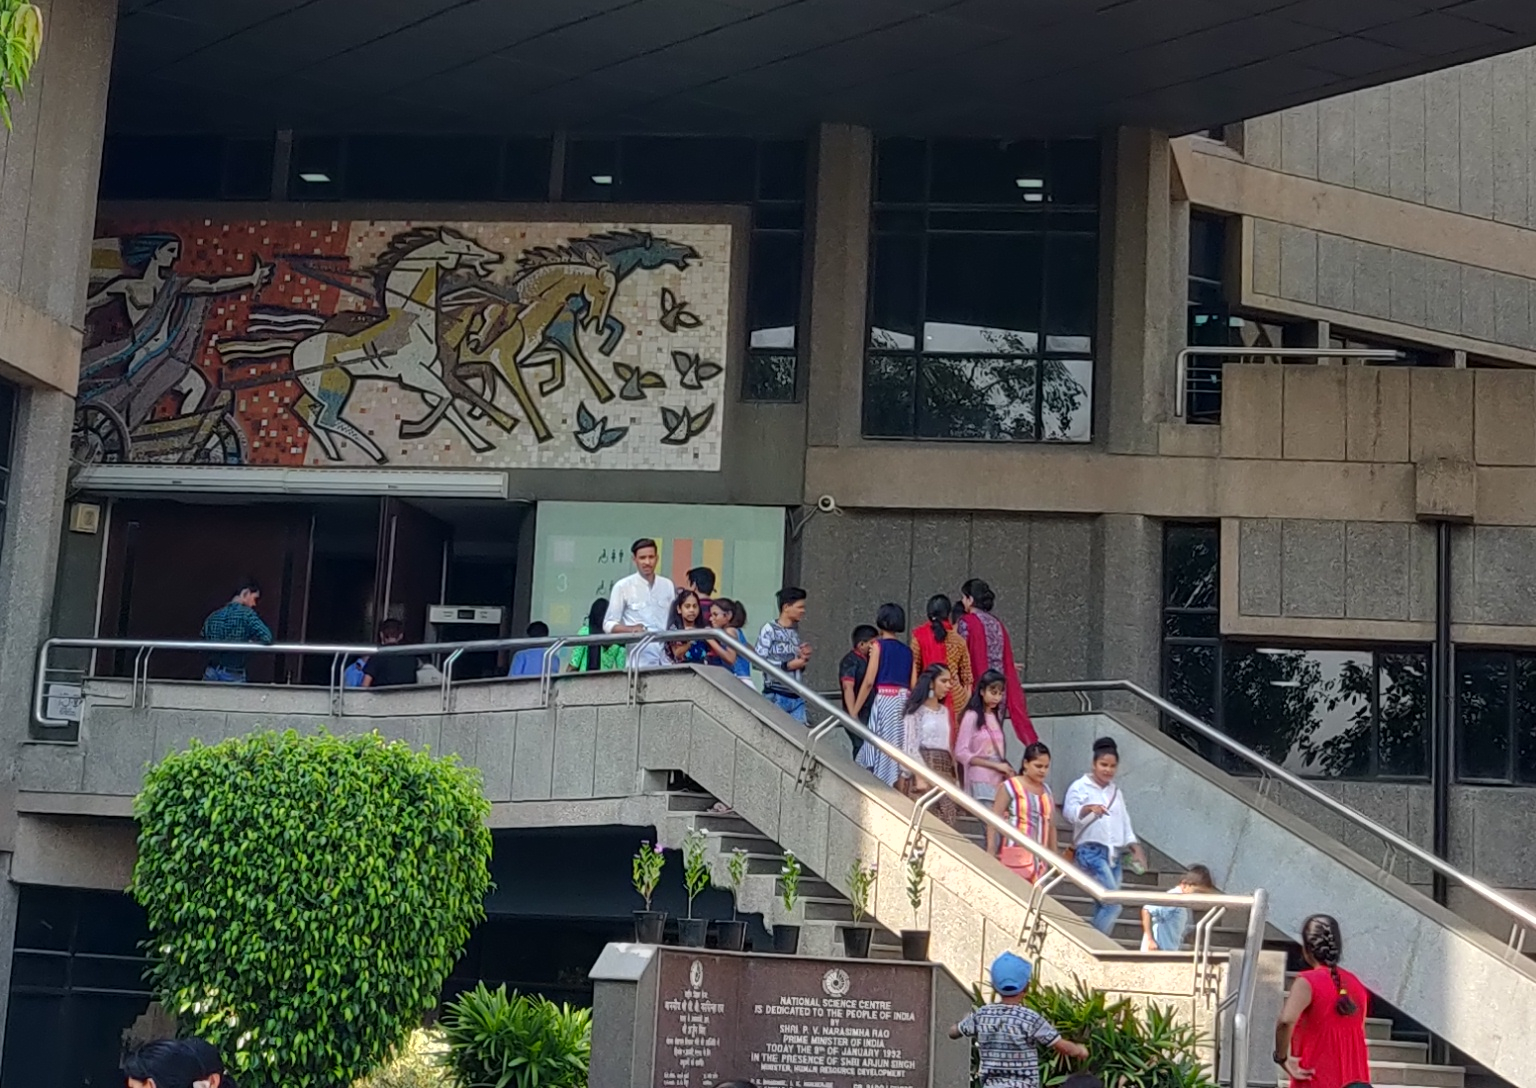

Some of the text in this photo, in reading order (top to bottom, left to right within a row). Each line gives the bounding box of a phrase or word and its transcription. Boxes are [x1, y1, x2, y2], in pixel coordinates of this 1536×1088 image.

[780, 996, 891, 1010] NATIONAL SCIENCE CENTRE
[754, 1005, 915, 1021] IS DEDICATED TO THE PEOPLE OF INDIA
[822, 1027, 870, 1037] NARASIMHA
[872, 1029, 890, 1038] RAO
[783, 1034, 885, 1048] PRIME MINISTER OF INDIA
[766, 1043, 794, 1053] TODAY
[796, 1044, 812, 1054] THE
[827, 1046, 838, 1055] OF
[841, 1047, 880, 1057] JANUARY
[883, 1049, 901, 1058] 1992
[750, 1052, 916, 1069] IN THE PRESENCE OF SHRI ARJUN SINGH
